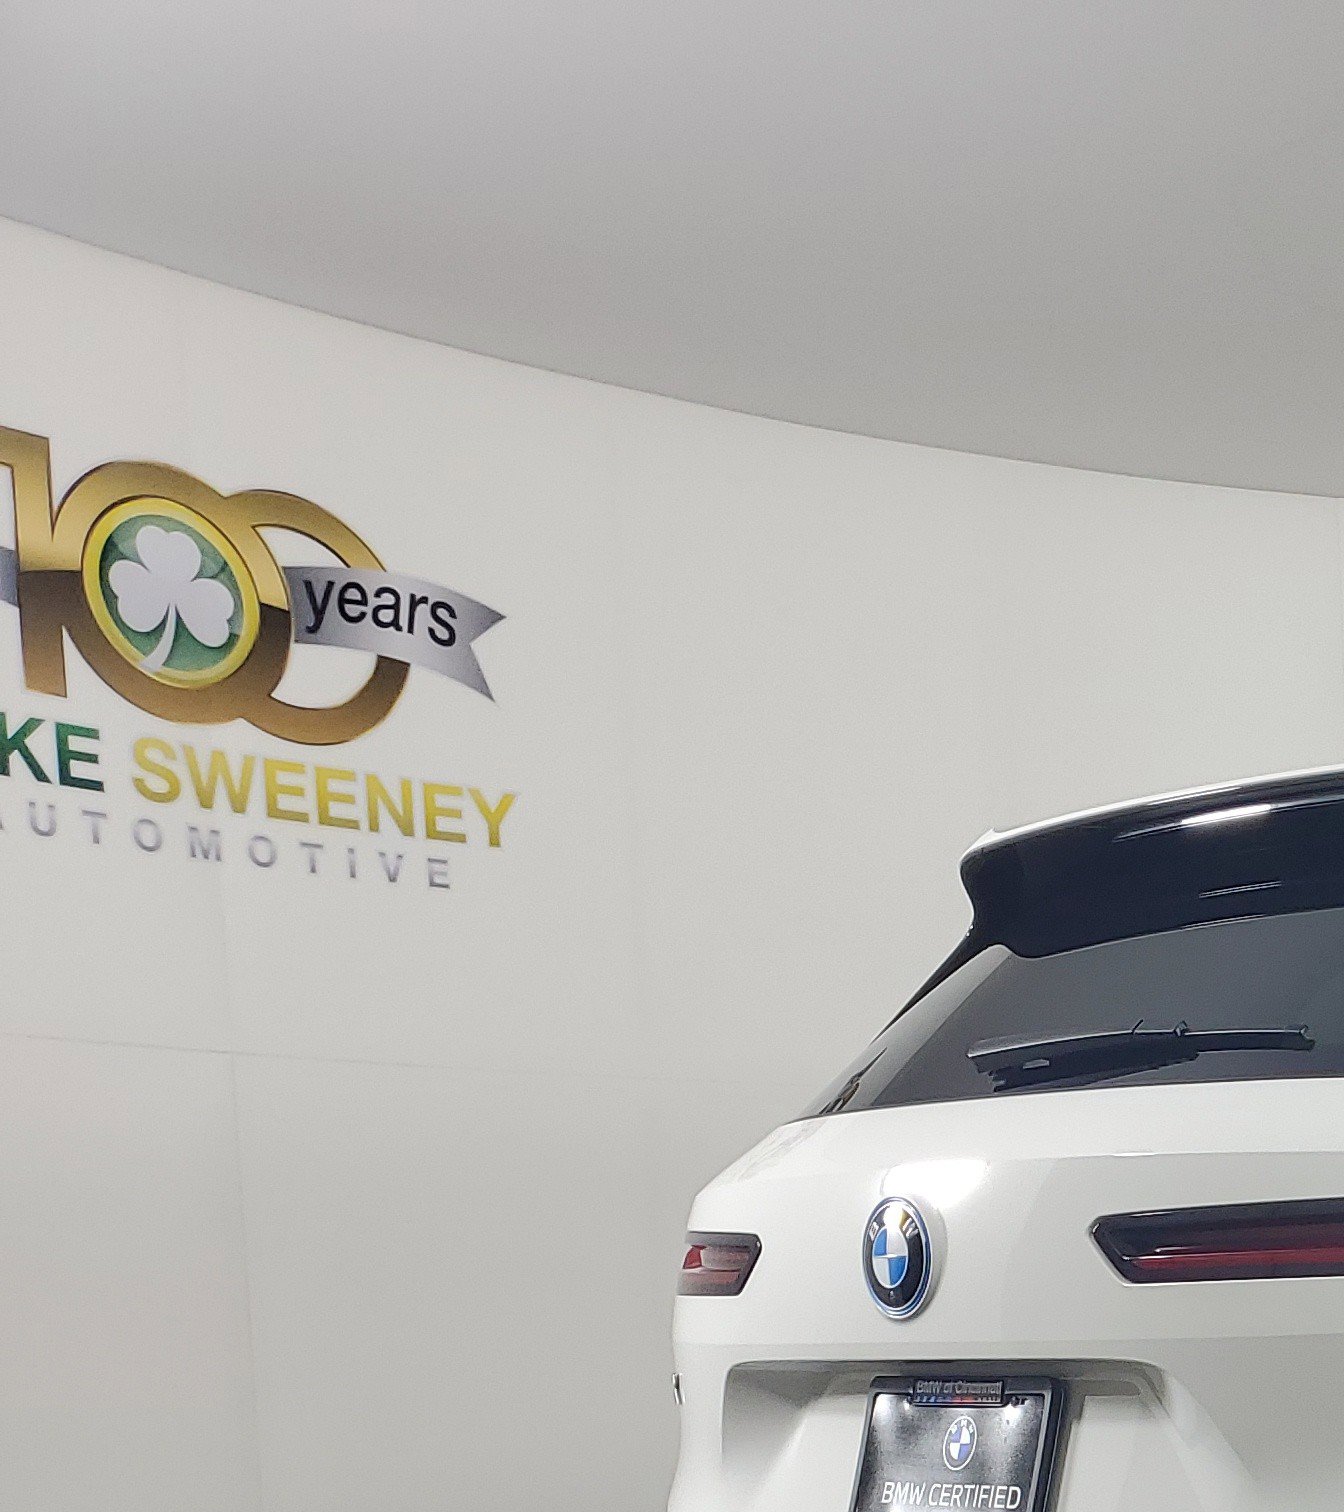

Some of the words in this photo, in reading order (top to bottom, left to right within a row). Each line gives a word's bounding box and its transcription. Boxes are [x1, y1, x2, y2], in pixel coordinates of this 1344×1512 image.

[0, 425, 410, 746] 100
[303, 578, 458, 648] years
[131, 736, 517, 848] SWEENEY
[0, 801, 451, 889] UTOMOTIVE
[881, 1481, 926, 1506] BMW
[928, 1483, 1022, 1510] CERTIFIED
